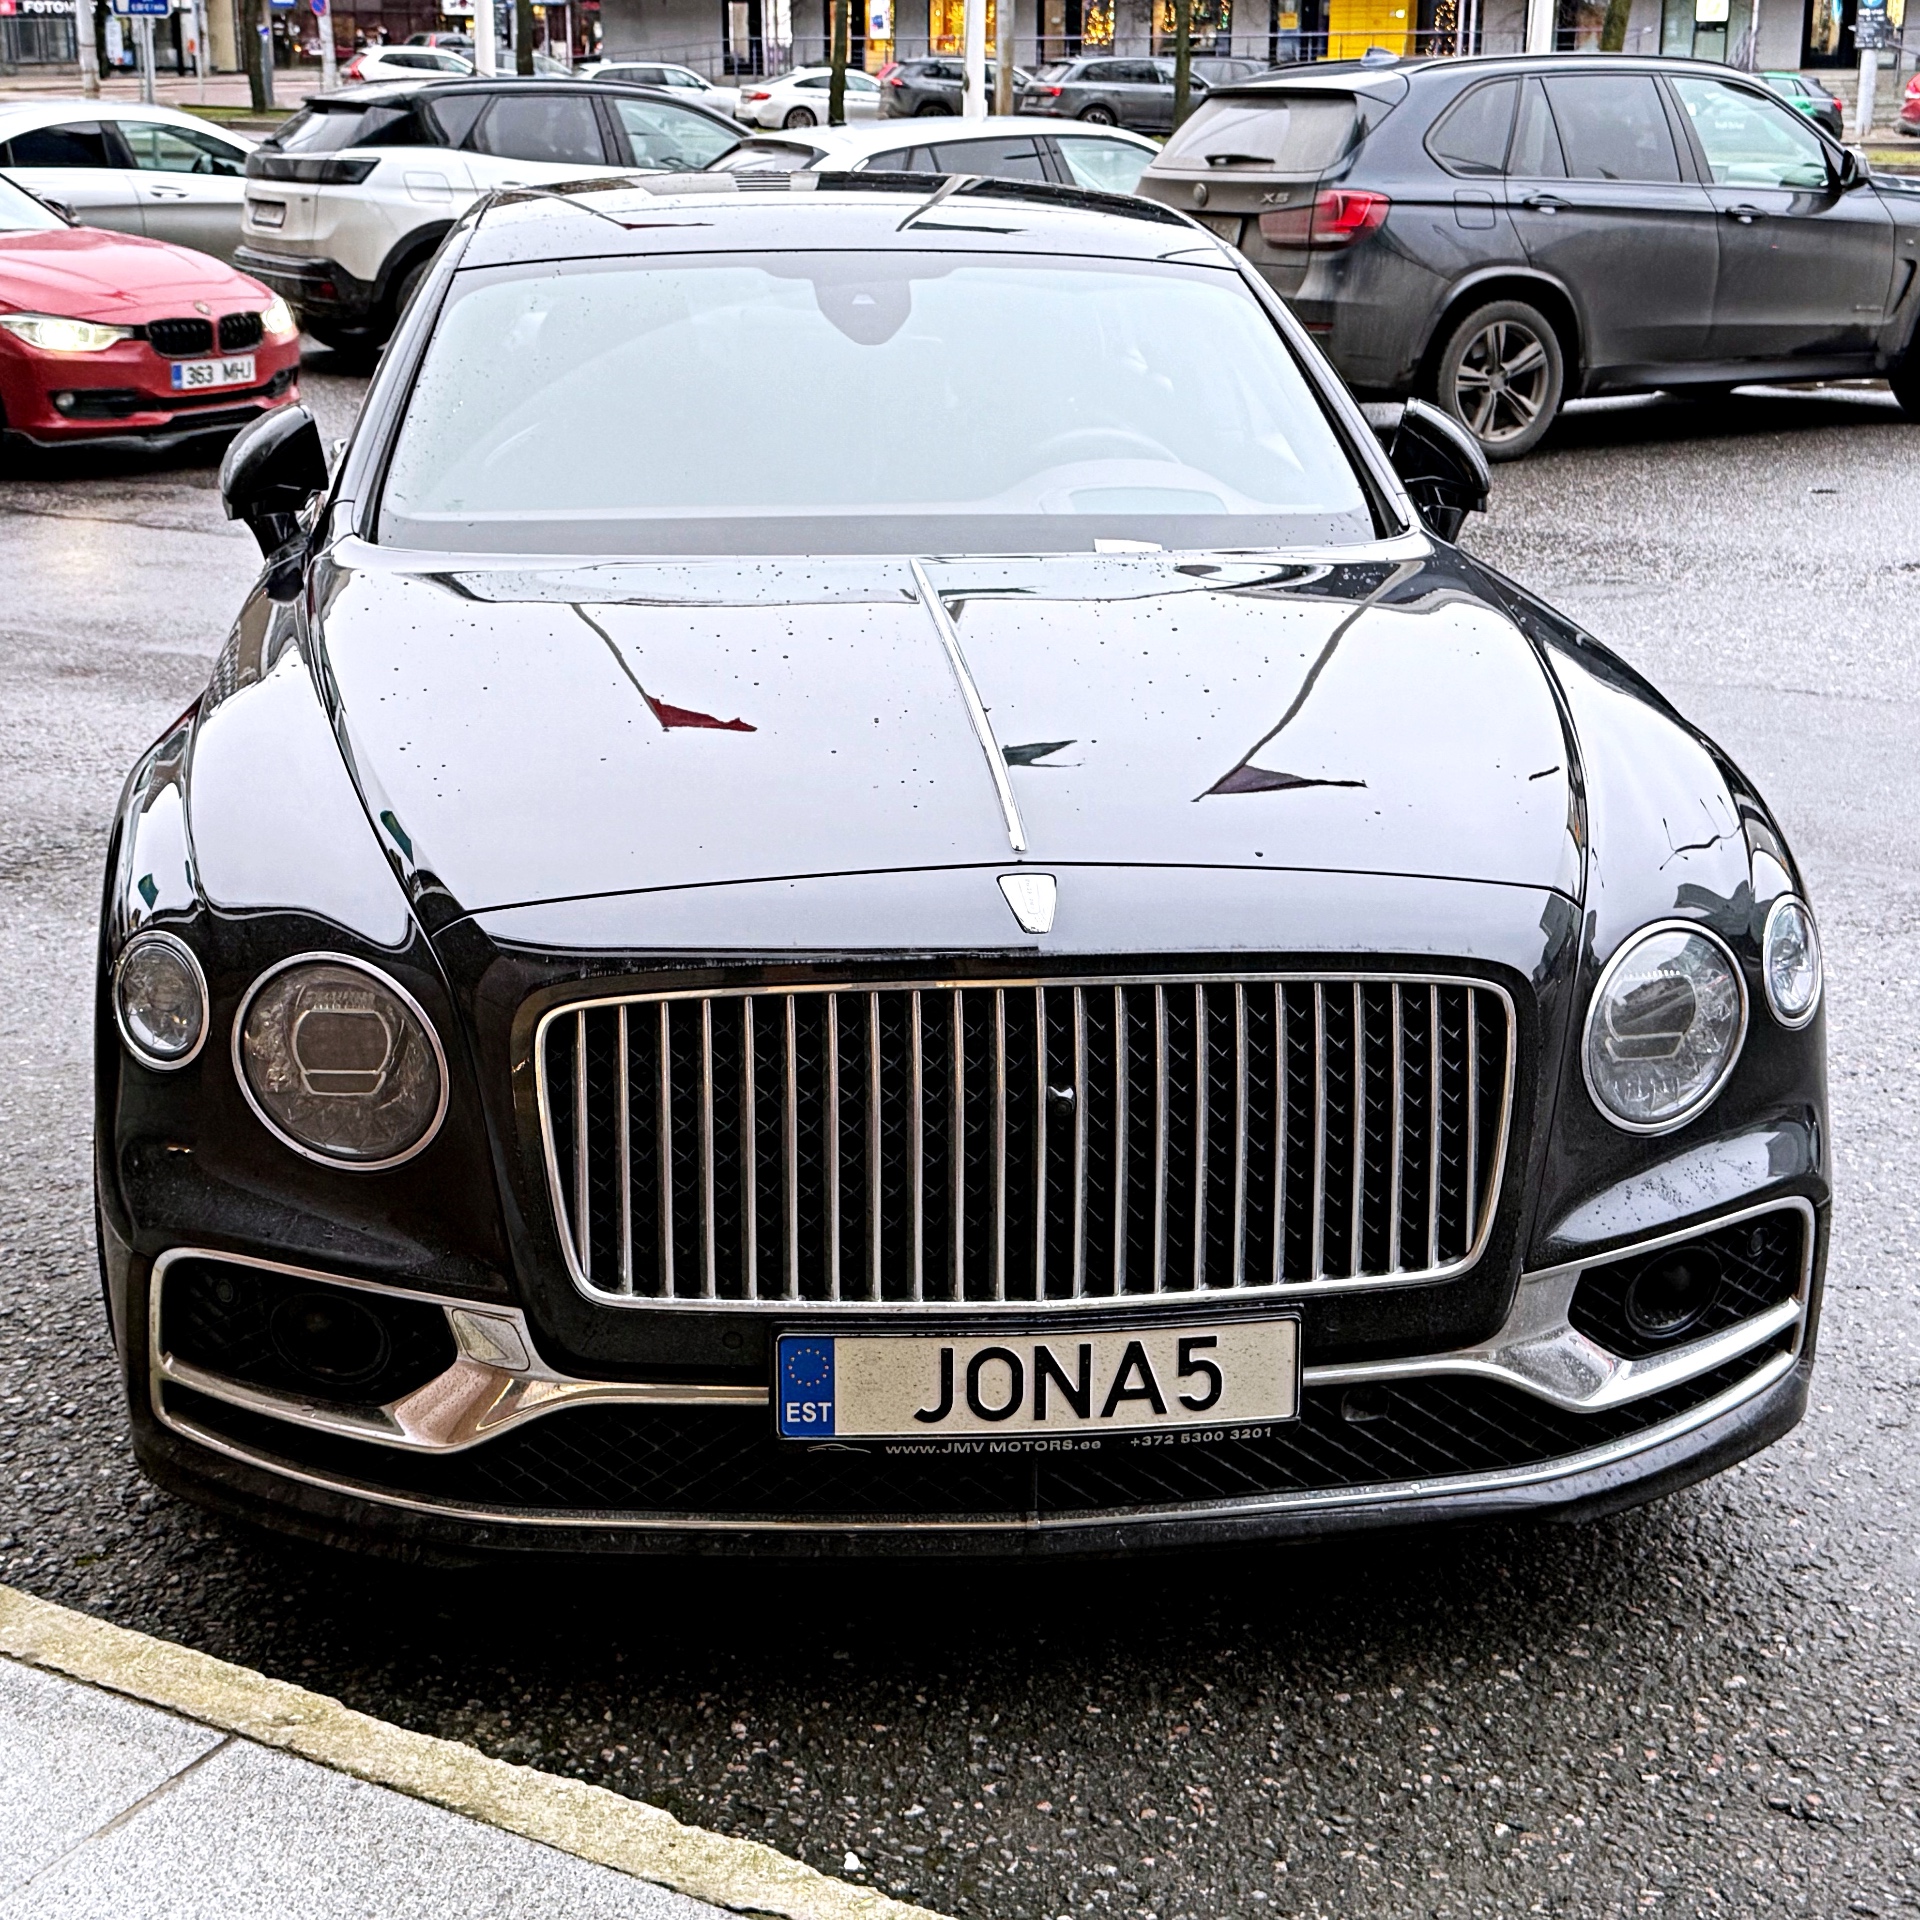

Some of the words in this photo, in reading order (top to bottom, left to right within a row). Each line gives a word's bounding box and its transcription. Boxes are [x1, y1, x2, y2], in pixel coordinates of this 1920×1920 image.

[1261, 192, 1290, 204] X5
[913, 1335, 1223, 1424] JONA5
[786, 1402, 832, 1422] EST
[1130, 1435, 1175, 1447] +372
[1180, 1431, 1225, 1444] 5300
[1229, 1427, 1272, 1440] 3201
